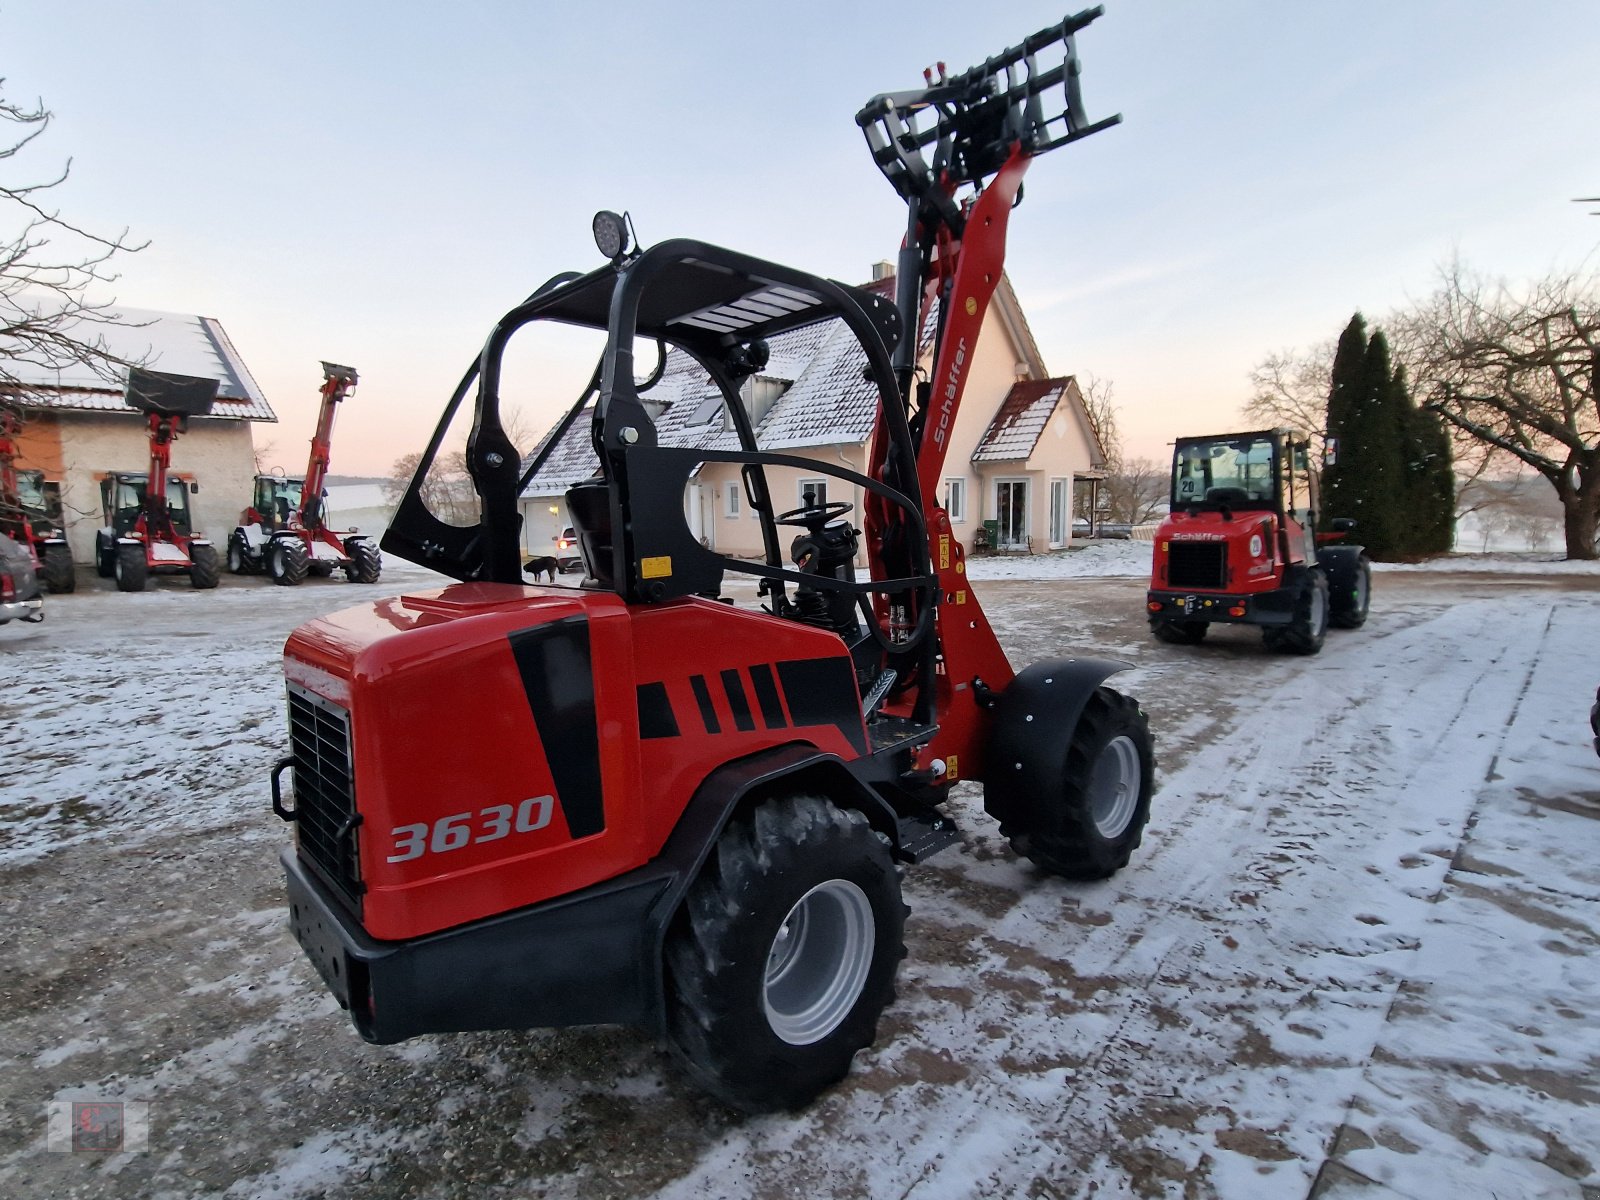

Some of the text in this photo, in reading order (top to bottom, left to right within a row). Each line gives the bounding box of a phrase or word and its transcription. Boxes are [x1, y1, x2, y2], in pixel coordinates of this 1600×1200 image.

[934, 337, 967, 452] Schäffer
[1182, 481, 1194, 492] 20
[387, 794, 554, 864] 3630
